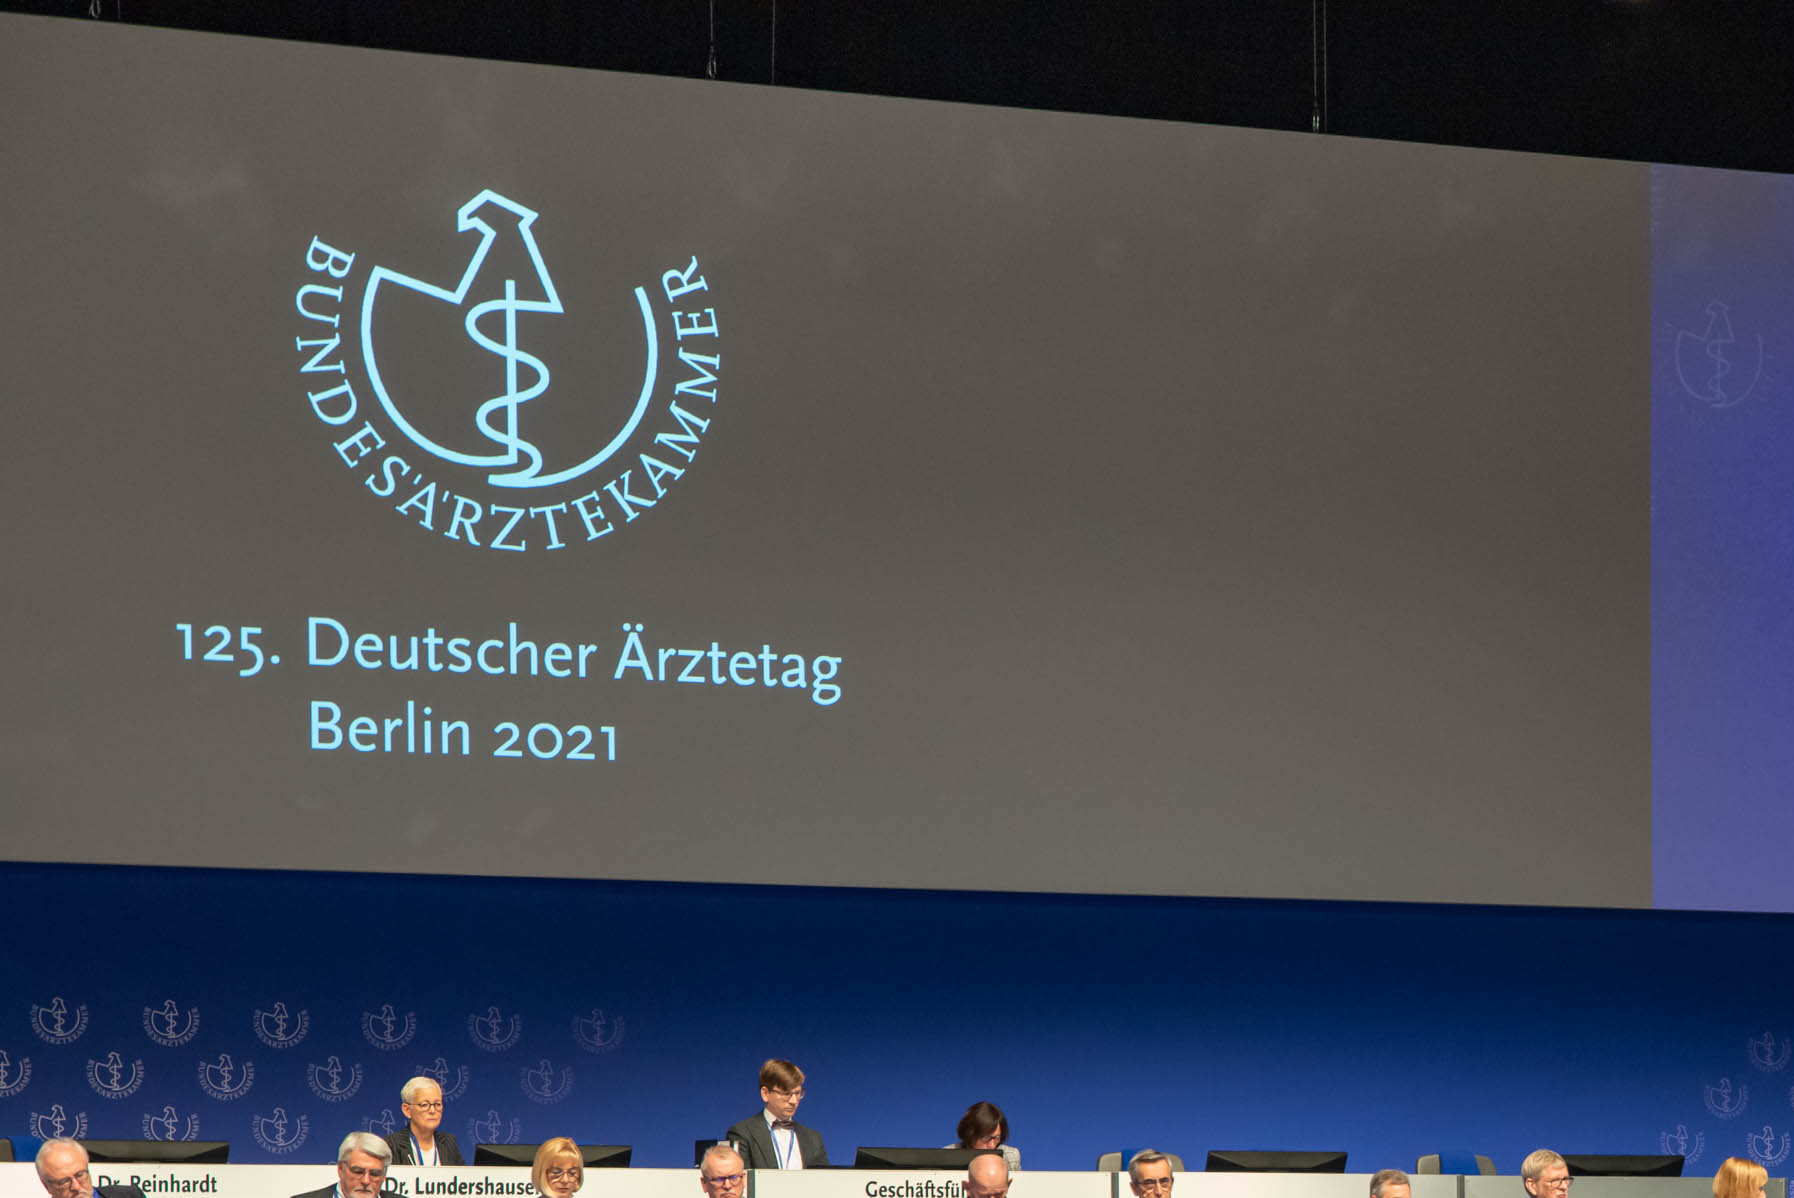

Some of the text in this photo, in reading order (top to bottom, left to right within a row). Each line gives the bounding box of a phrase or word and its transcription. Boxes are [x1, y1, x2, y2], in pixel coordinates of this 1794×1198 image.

[295, 235, 720, 552] BUNDESÄRZTEKAMMER
[176, 615, 843, 706] 125. Deutscher Ärztetag
[309, 699, 617, 761] Berlin 2021
[130, 1173, 218, 1193] Reinhardt
[385, 1175, 539, 1195] Dr. Lundershause
